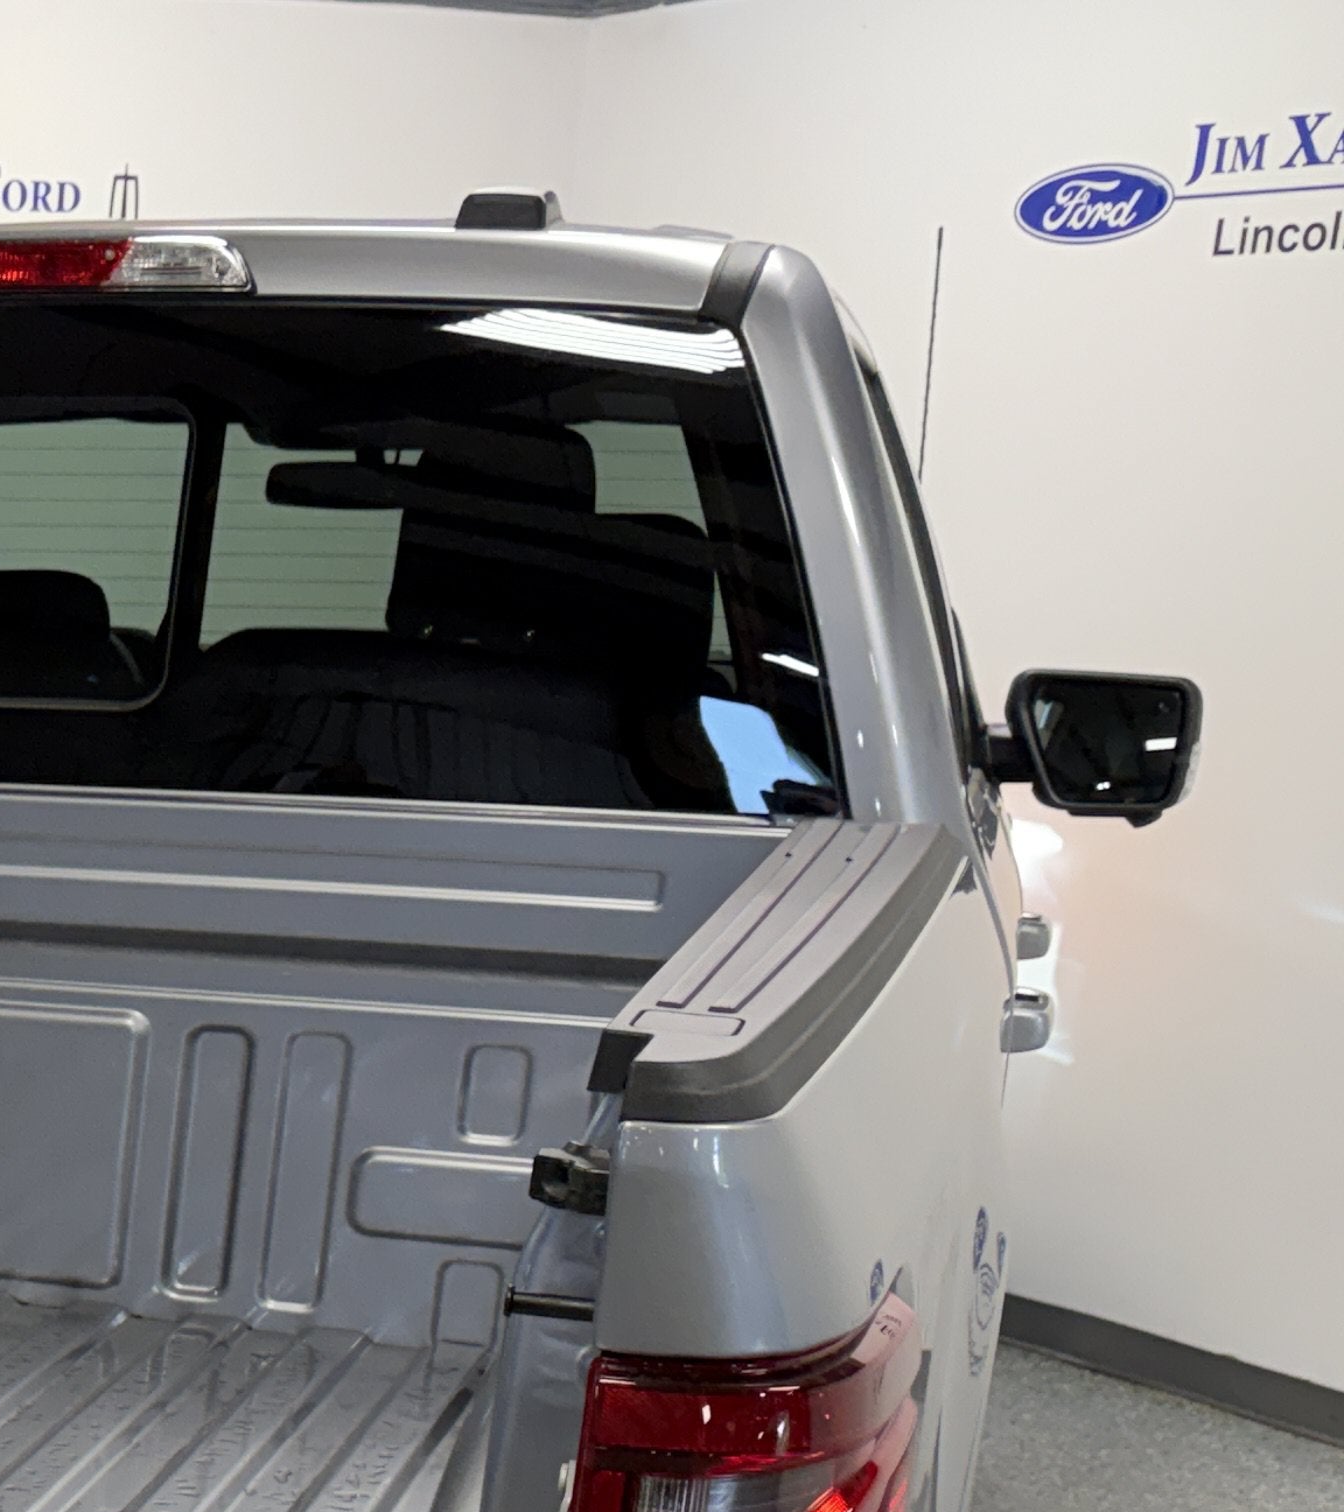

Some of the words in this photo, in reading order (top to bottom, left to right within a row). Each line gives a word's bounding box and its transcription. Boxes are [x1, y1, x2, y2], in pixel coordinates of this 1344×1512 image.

[1184, 122, 1270, 187] JIM
[1042, 179, 1144, 232] Ford
[1212, 210, 1344, 257] Lincol
